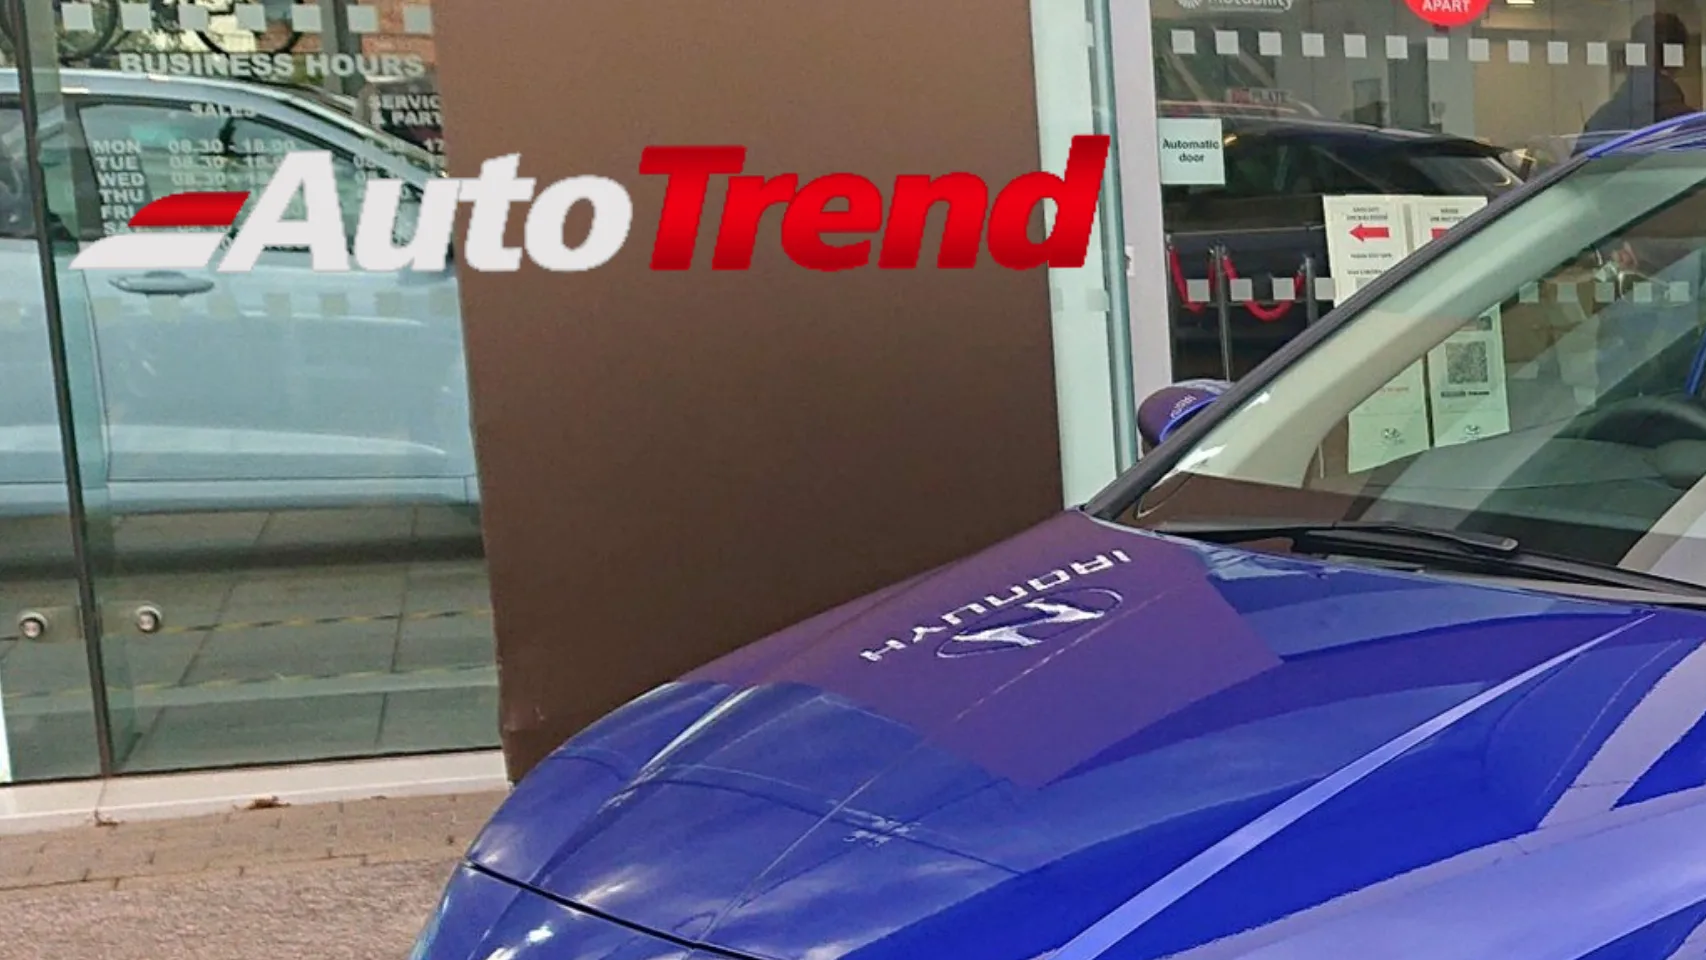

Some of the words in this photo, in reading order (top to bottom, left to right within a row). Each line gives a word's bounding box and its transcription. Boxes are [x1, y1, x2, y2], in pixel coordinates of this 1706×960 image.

[1421, 0, 1472, 13] APART
[120, 53, 294, 76] BUSINESS
[306, 54, 426, 77] HOURS
[369, 94, 442, 110] SERVIC
[190, 102, 257, 118] SALES
[392, 111, 443, 126] PART
[92, 139, 142, 154] MON
[1162, 138, 1220, 151] Automatic
[94, 156, 139, 170] TUE
[1178, 153, 1205, 163] door
[97, 172, 146, 187] WED
[98, 188, 144, 203] THU
[100, 205, 136, 219] FRI
